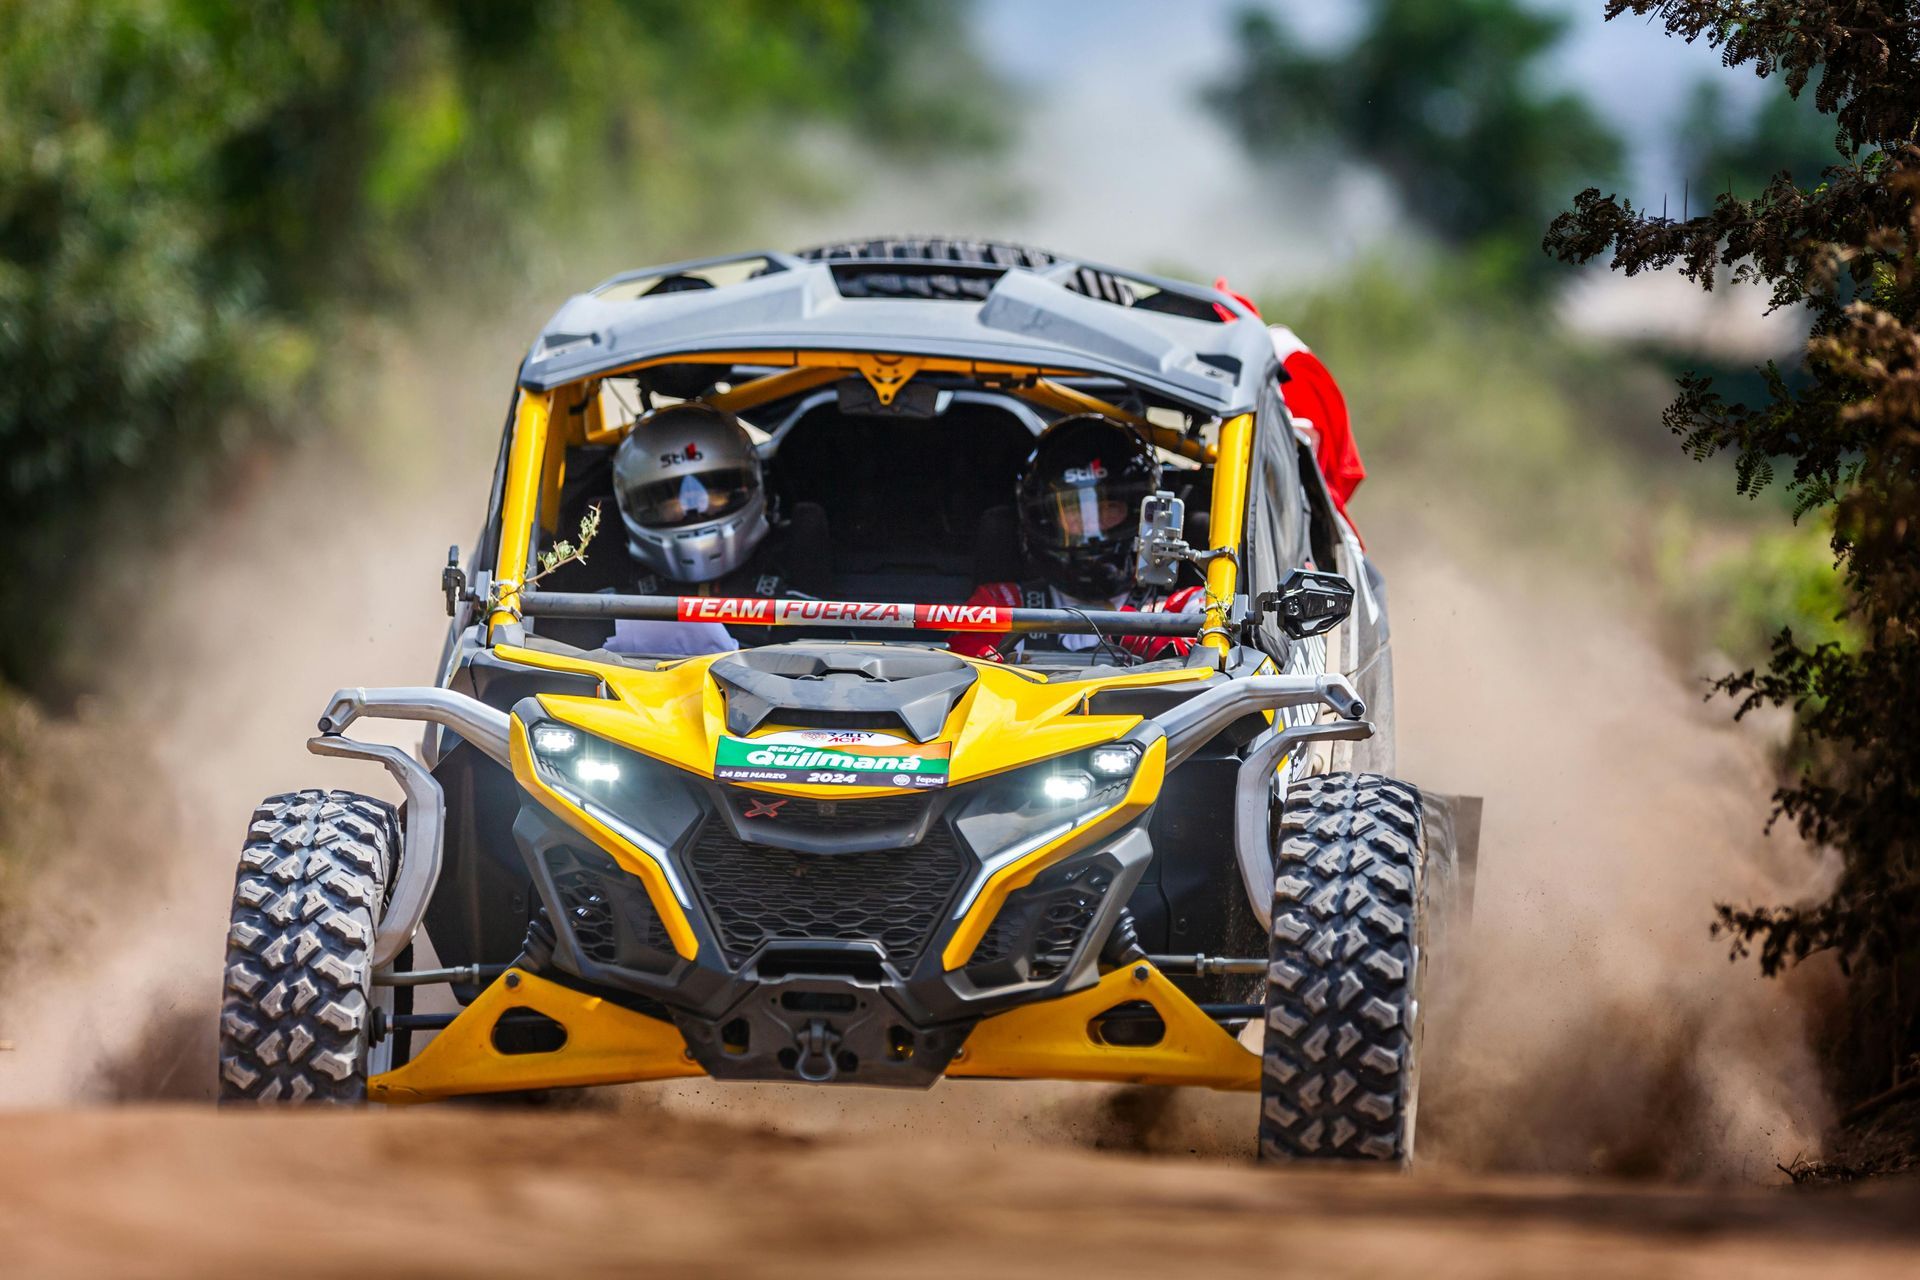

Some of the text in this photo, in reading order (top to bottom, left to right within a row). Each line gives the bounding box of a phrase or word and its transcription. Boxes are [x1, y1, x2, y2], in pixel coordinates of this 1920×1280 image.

[1064, 459, 1108, 483] Stilo
[683, 598, 998, 624] TEAM FUERZA INKA
[766, 745, 806, 753] Rally
[746, 750, 921, 770] Quilmaná
[749, 771, 787, 779] MARZO
[807, 772, 858, 784] 2024
[915, 775, 944, 784] fepad
